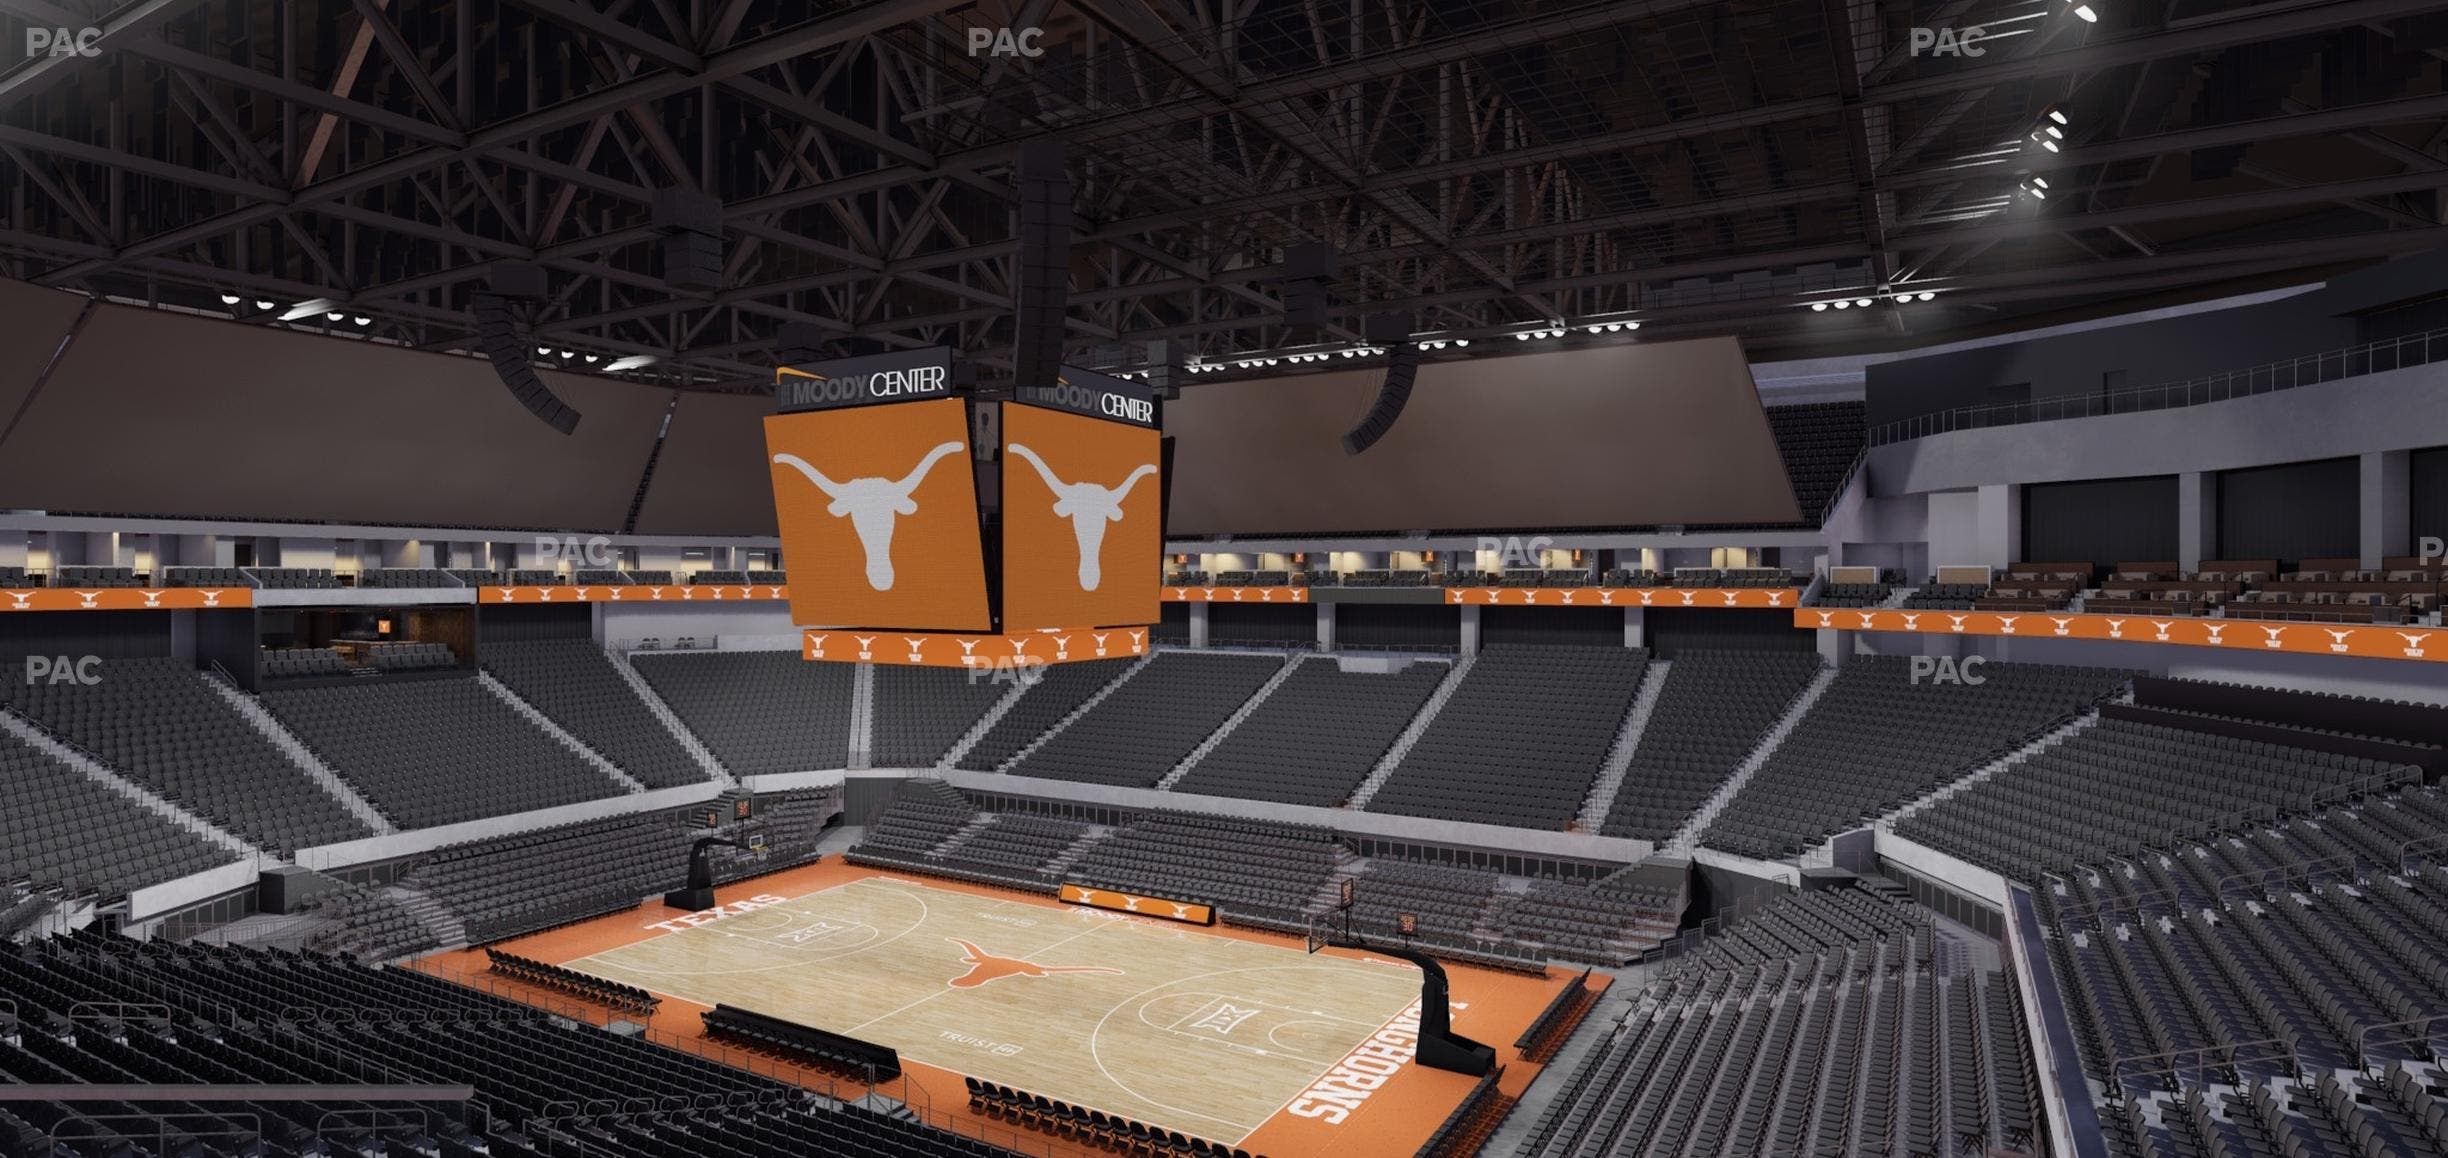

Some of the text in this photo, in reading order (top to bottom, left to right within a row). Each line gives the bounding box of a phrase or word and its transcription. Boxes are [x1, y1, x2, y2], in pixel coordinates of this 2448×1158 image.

[793, 366, 946, 405] MOODY CENTER
[1040, 383, 1153, 423] MOODY CENTER
[643, 893, 787, 934] TEXAS
[938, 1030, 998, 1049] TRUIST
